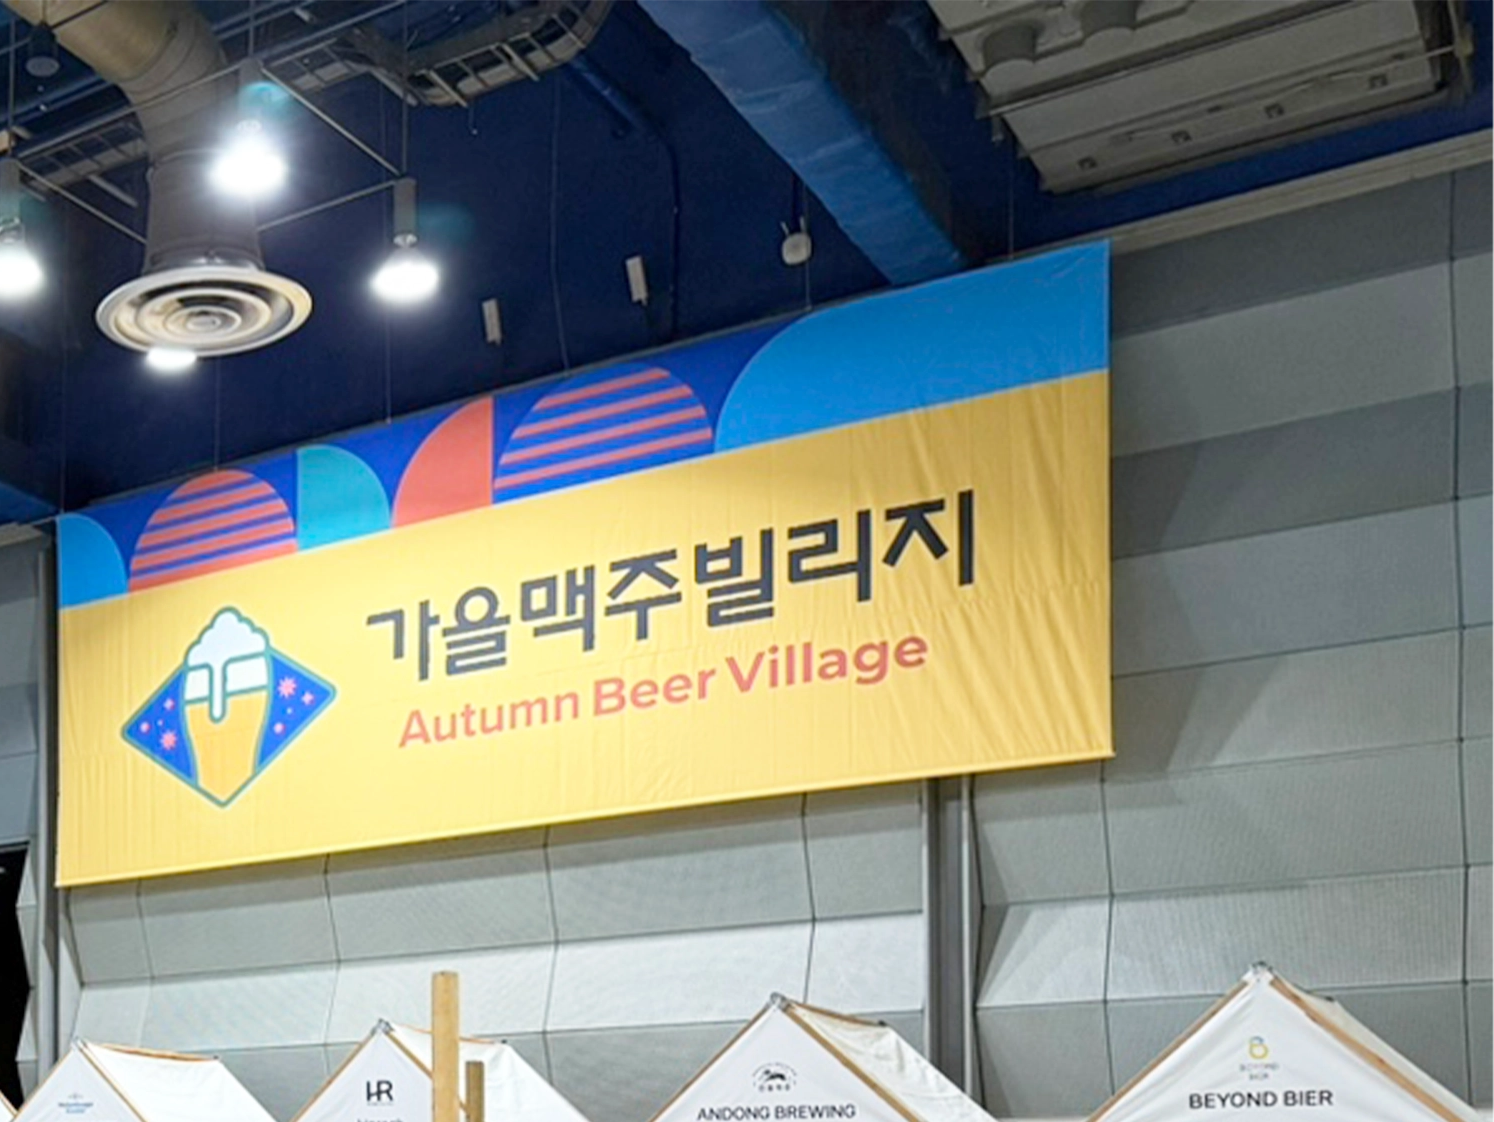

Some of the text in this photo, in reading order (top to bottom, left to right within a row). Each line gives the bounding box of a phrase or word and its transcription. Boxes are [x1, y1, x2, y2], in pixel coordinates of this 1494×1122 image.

[366, 489, 975, 682] 가을맥주빌리지
[398, 633, 928, 748] Autumn Beer Village
[697, 1103, 857, 1121] ANDONG BREWING
[1188, 1090, 1334, 1109] BEYOND BIER
